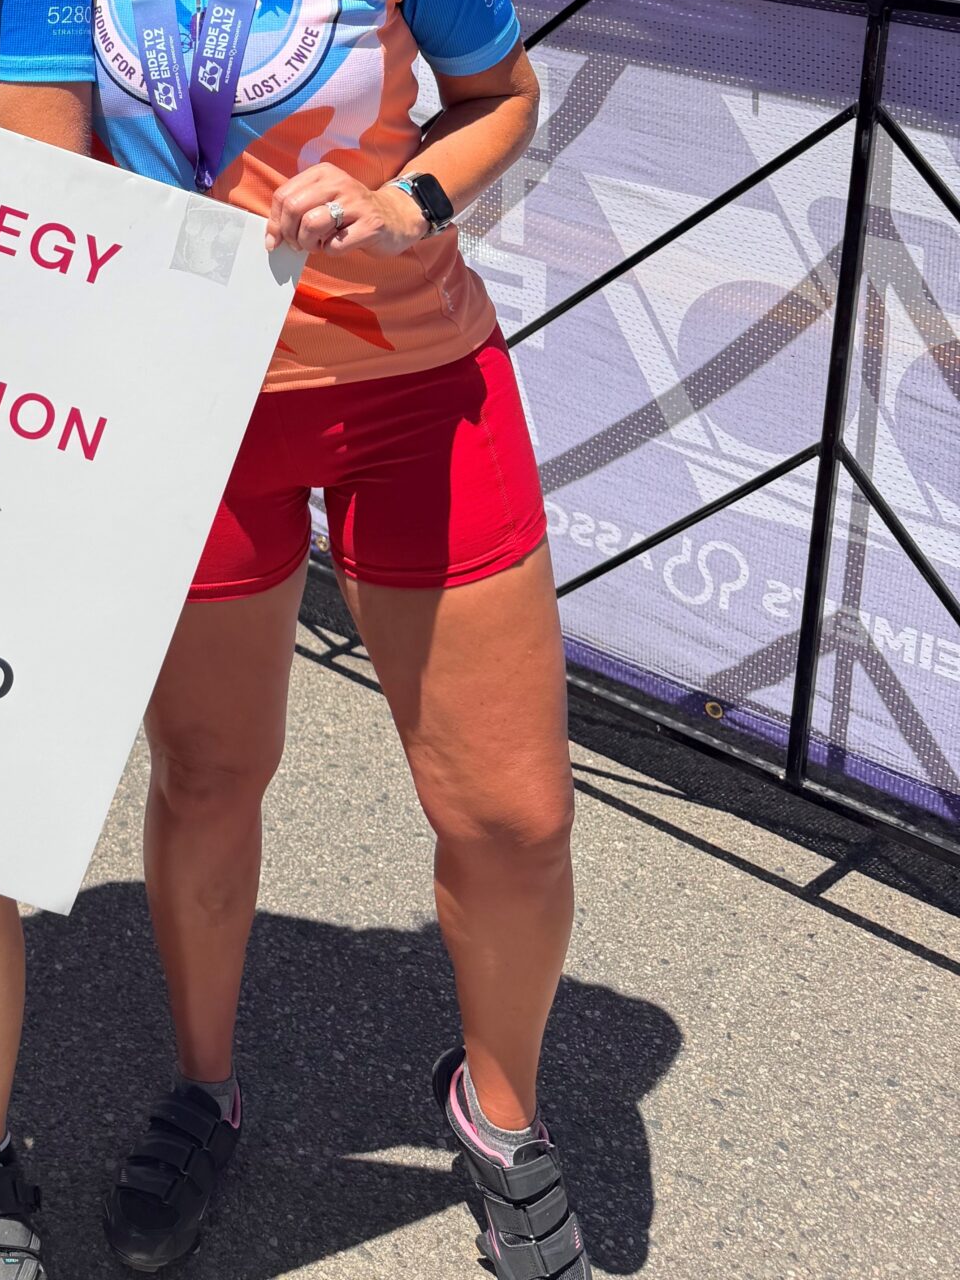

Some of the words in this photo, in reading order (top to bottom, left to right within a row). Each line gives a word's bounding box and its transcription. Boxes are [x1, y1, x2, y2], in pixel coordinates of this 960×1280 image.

[210, 6, 223, 24] TO
[221, 8, 236, 32] ALZ
[94, 5, 115, 53] RIDING
[111, 52, 137, 80] FOR
[143, 29, 154, 48] TO
[153, 27, 167, 51] ALZ
[202, 27, 219, 57] RIDE
[214, 33, 229, 60] END
[146, 49, 160, 80] RIDE
[157, 51, 171, 78] END
